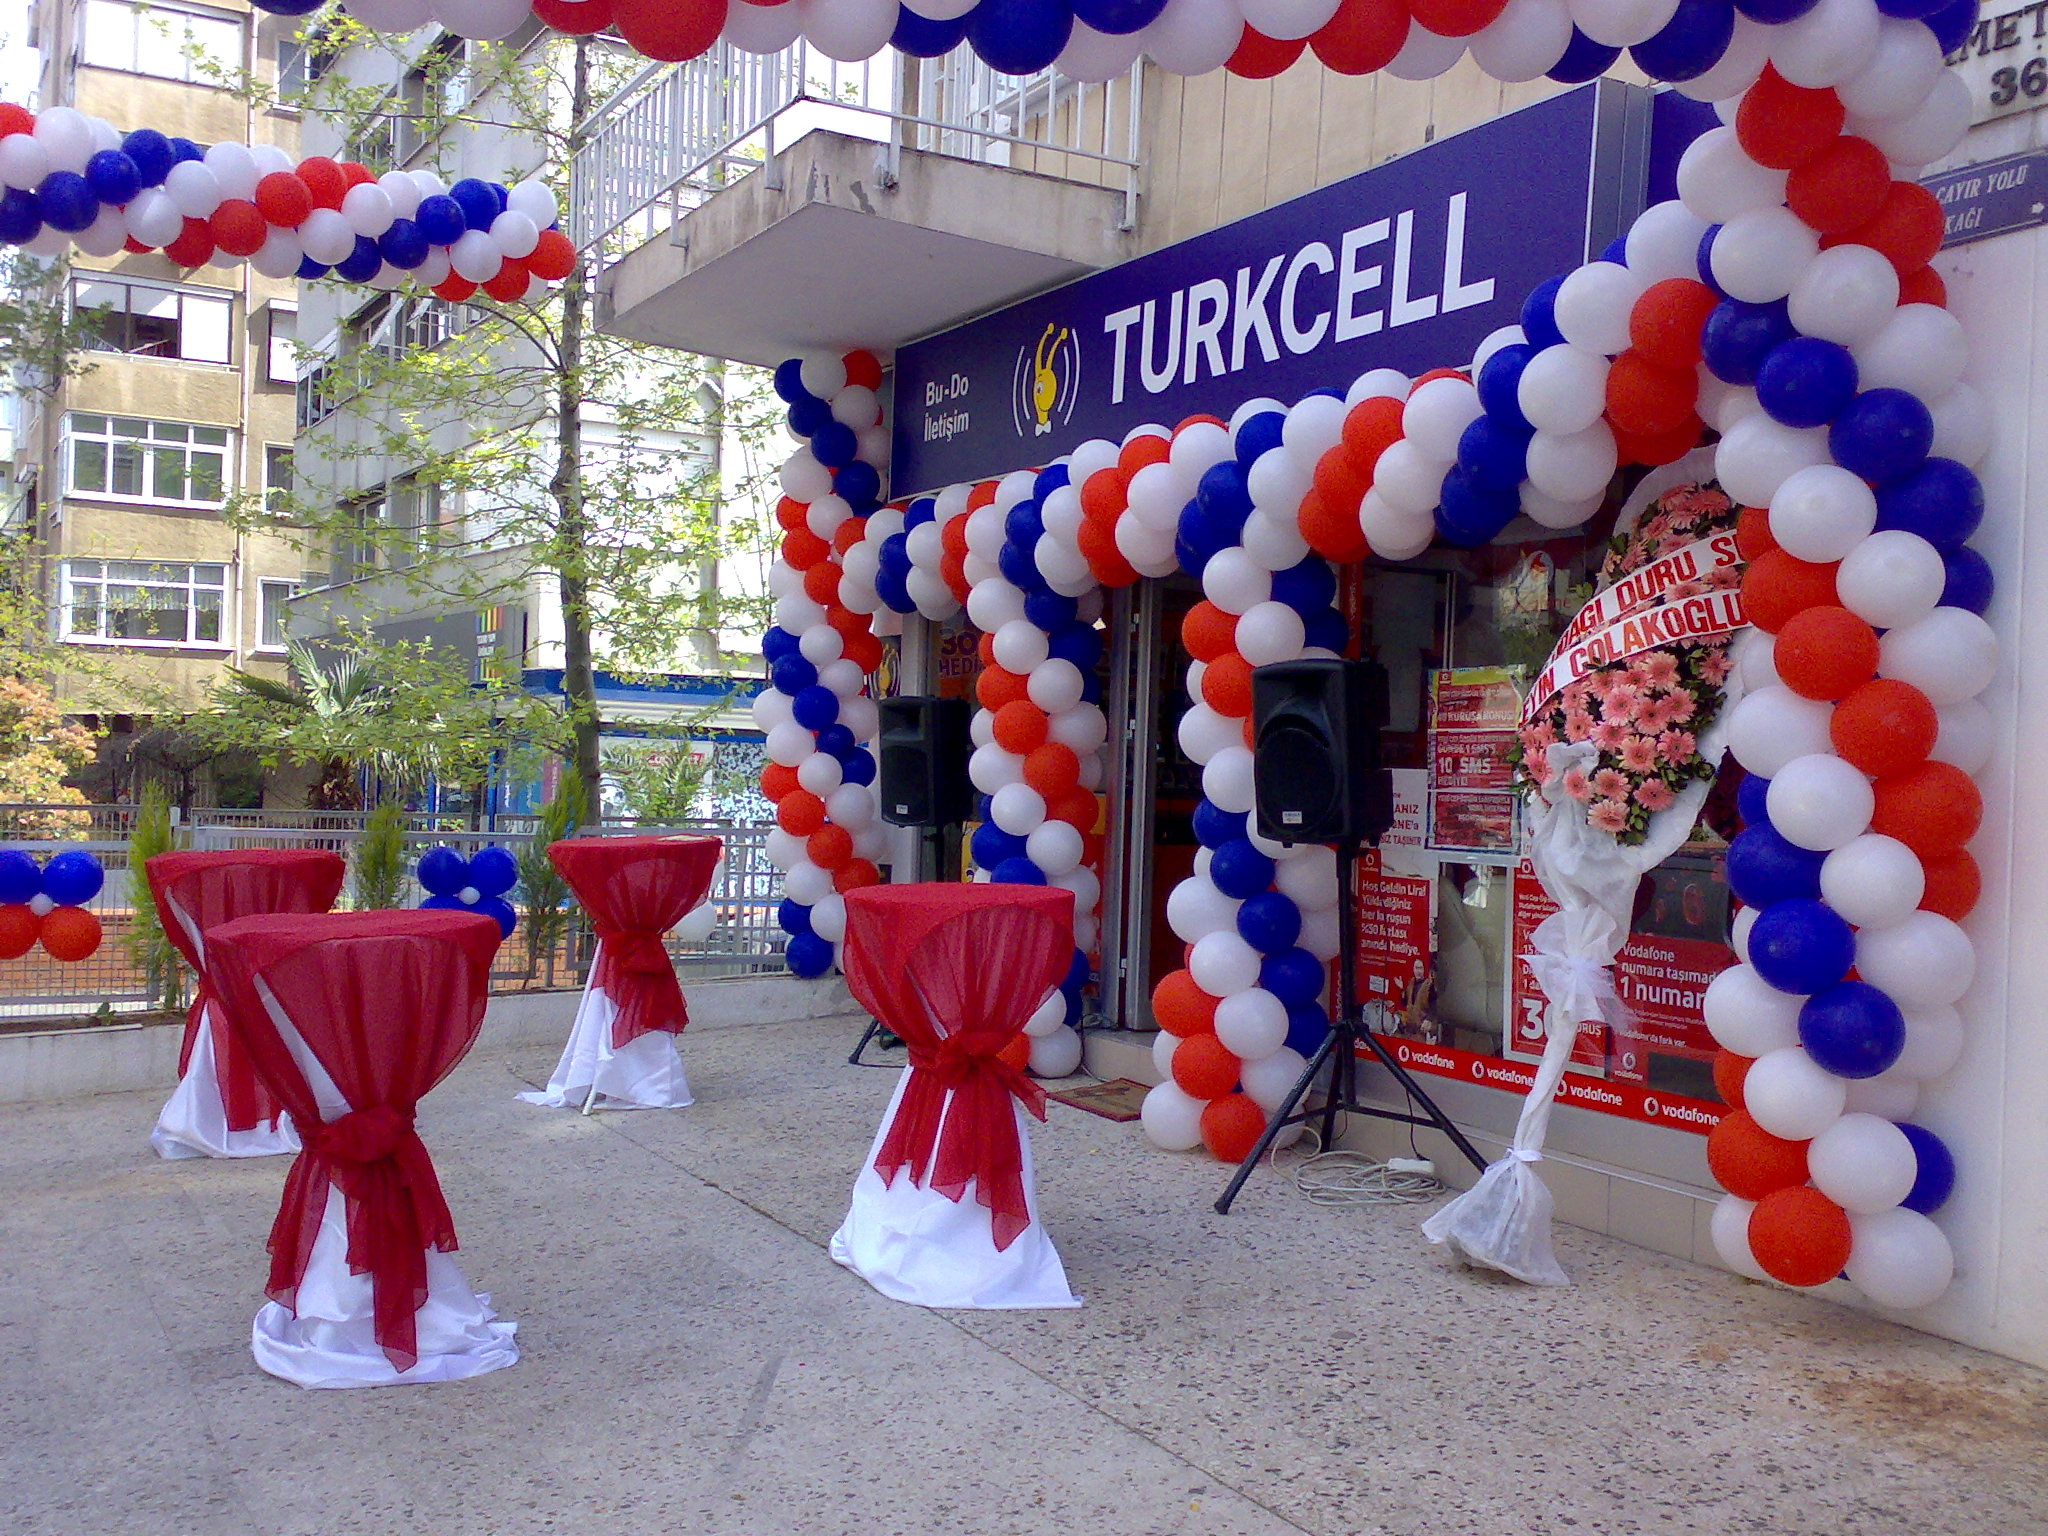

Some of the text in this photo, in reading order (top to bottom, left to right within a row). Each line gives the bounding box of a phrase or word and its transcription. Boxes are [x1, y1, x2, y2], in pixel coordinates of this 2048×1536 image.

[1990, 57, 2047, 105] 36
[1987, 165, 2028, 193] YOLU
[1944, 206, 1983, 234] KAĞI
[1104, 191, 1495, 405] TURKCELL
[925, 373, 969, 407] Bu-Do
[924, 409, 969, 442] İletişim
[1615, 550, 1697, 612] DURU
[1518, 667, 1556, 728] EYIN
[1460, 757, 1491, 774] SMS
[1623, 942, 1676, 962] Vodafone
[1621, 962, 1718, 985] numara taşımad
[1620, 975, 1707, 1010] 1 numar
[1520, 997, 1545, 1040] 3
[1411, 1051, 1456, 1070] vodafone
[1487, 1066, 1535, 1088] vodafone
[1570, 1085, 1623, 1107] vodafone
[1661, 1104, 1720, 1127] vodafone
